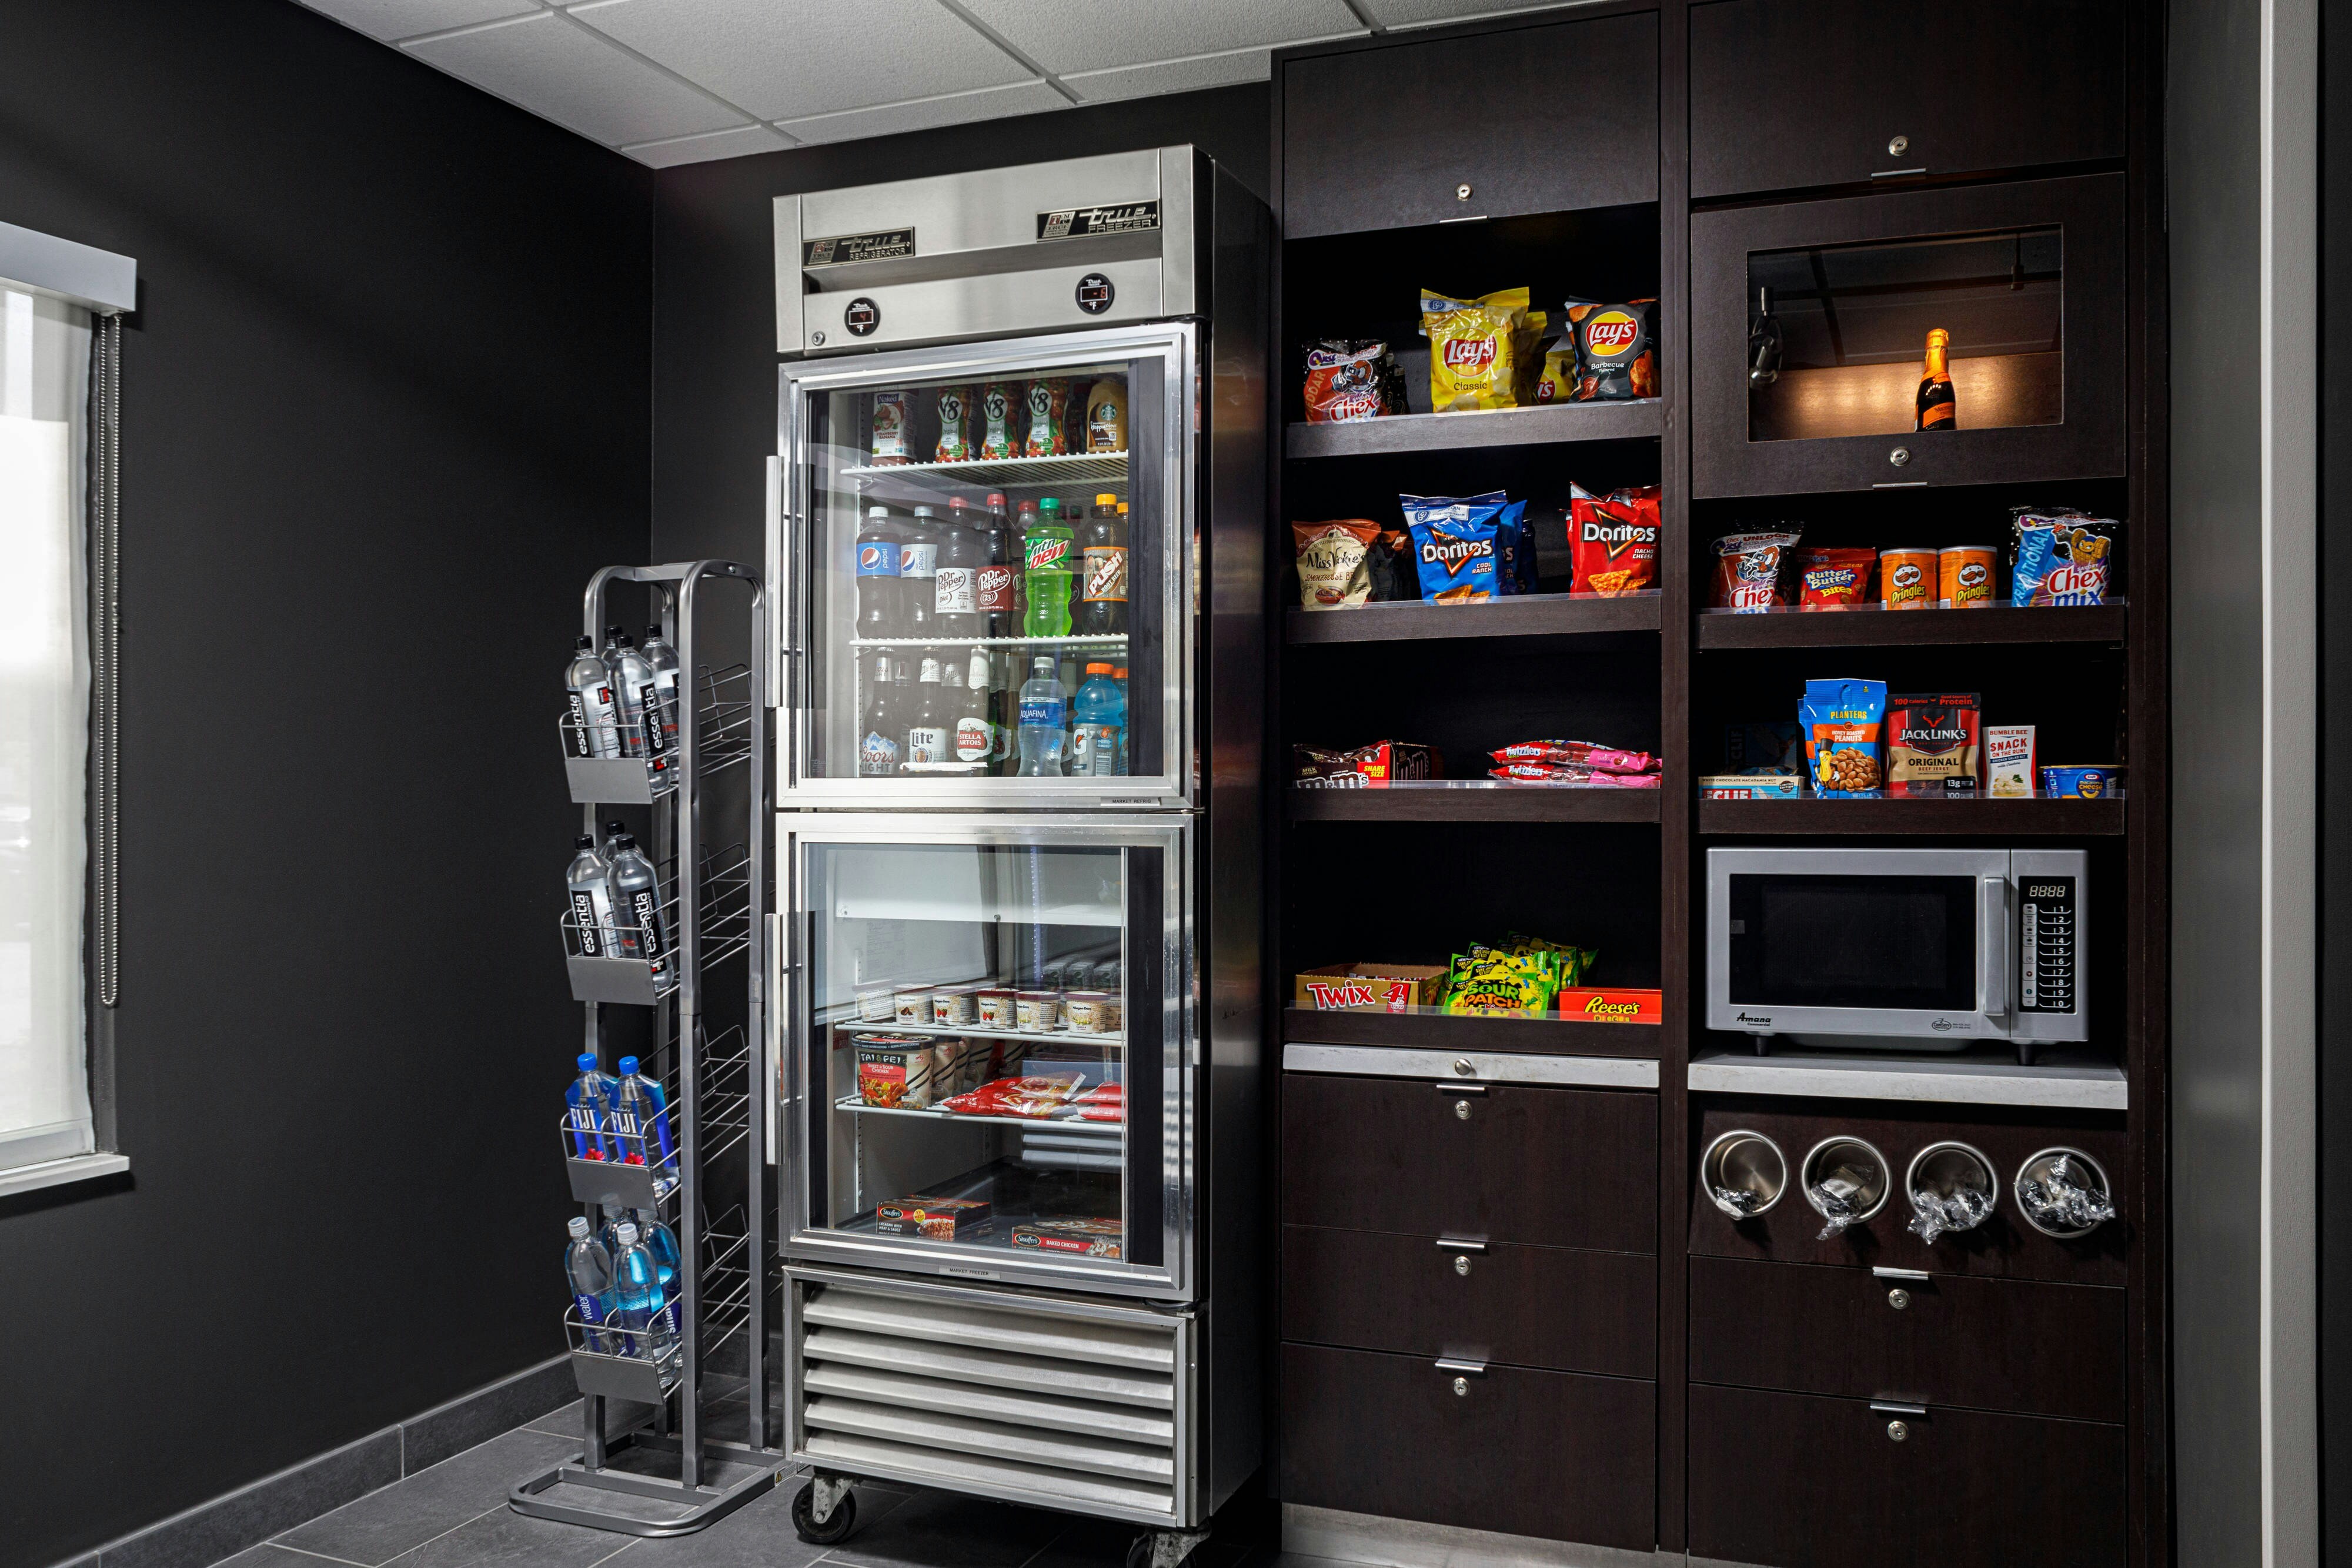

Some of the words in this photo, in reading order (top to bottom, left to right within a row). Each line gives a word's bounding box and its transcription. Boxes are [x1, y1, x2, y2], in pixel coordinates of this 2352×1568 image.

[1088, 219, 1151, 233] FREEZER
[849, 248, 906, 260] REFRIGERATOR
[1589, 320, 1635, 346] Lay's
[1448, 337, 1494, 367] Lay's
[1591, 362, 1625, 370] Barbecue
[1454, 381, 1488, 391] Classic
[939, 394, 959, 420] V8
[985, 392, 1004, 419] V8
[1030, 386, 1049, 413] V8
[1331, 393, 1377, 422] Chex
[1584, 523, 1655, 542] Doritos
[1743, 533, 1790, 542] UNLOCK
[1306, 552, 1332, 569] Miss
[1329, 546, 1365, 567] Vickie's
[1423, 539, 1493, 562] Doritos
[937, 574, 963, 591] Pepper
[943, 571, 956, 581] Dr
[978, 573, 1008, 591] Pepper
[987, 570, 1000, 580] Dr
[1304, 571, 1343, 581] SMOKEHOUSE
[1805, 569, 1852, 583] Nutter
[1810, 574, 1856, 589] Butter
[2050, 566, 2106, 593] Chex
[1730, 586, 1775, 608] Chex
[1820, 586, 1852, 597] Bites
[1892, 583, 1925, 607] Pringles
[1957, 583, 1990, 607] Pringles
[1020, 709, 1047, 718] AQUAFINA
[1830, 711, 1867, 720] PLANTERS
[912, 732, 933, 747] Lite
[1899, 729, 1930, 741] JACK
[1931, 728, 1966, 740] LINK'S
[1505, 745, 1541, 757] Twizzlers
[1990, 738, 2027, 751] SNACK
[863, 745, 895, 763] Coors
[861, 763, 891, 773] LIGHT
[1909, 758, 1959, 766] ORIGINAL
[1509, 765, 1544, 776] Twizzlers
[1947, 780, 1960, 788] 13g
[576, 895, 595, 953] essentia
[1381, 984, 1404, 1004] 4
[1467, 983, 1519, 1000] SOUR
[1464, 993, 1522, 1008] PATCH
[1585, 996, 1641, 1015] Reese's
[1736, 1012, 1772, 1022] Amana
[861, 1054, 874, 1062] TAI
[883, 1055, 901, 1064] PEI
[570, 1108, 597, 1130] FIJI
[610, 1111, 637, 1134] FIJI
[883, 1209, 901, 1218] Stouffer's
[1018, 1235, 1038, 1245] Stouffer's
[580, 1295, 593, 1320] water
